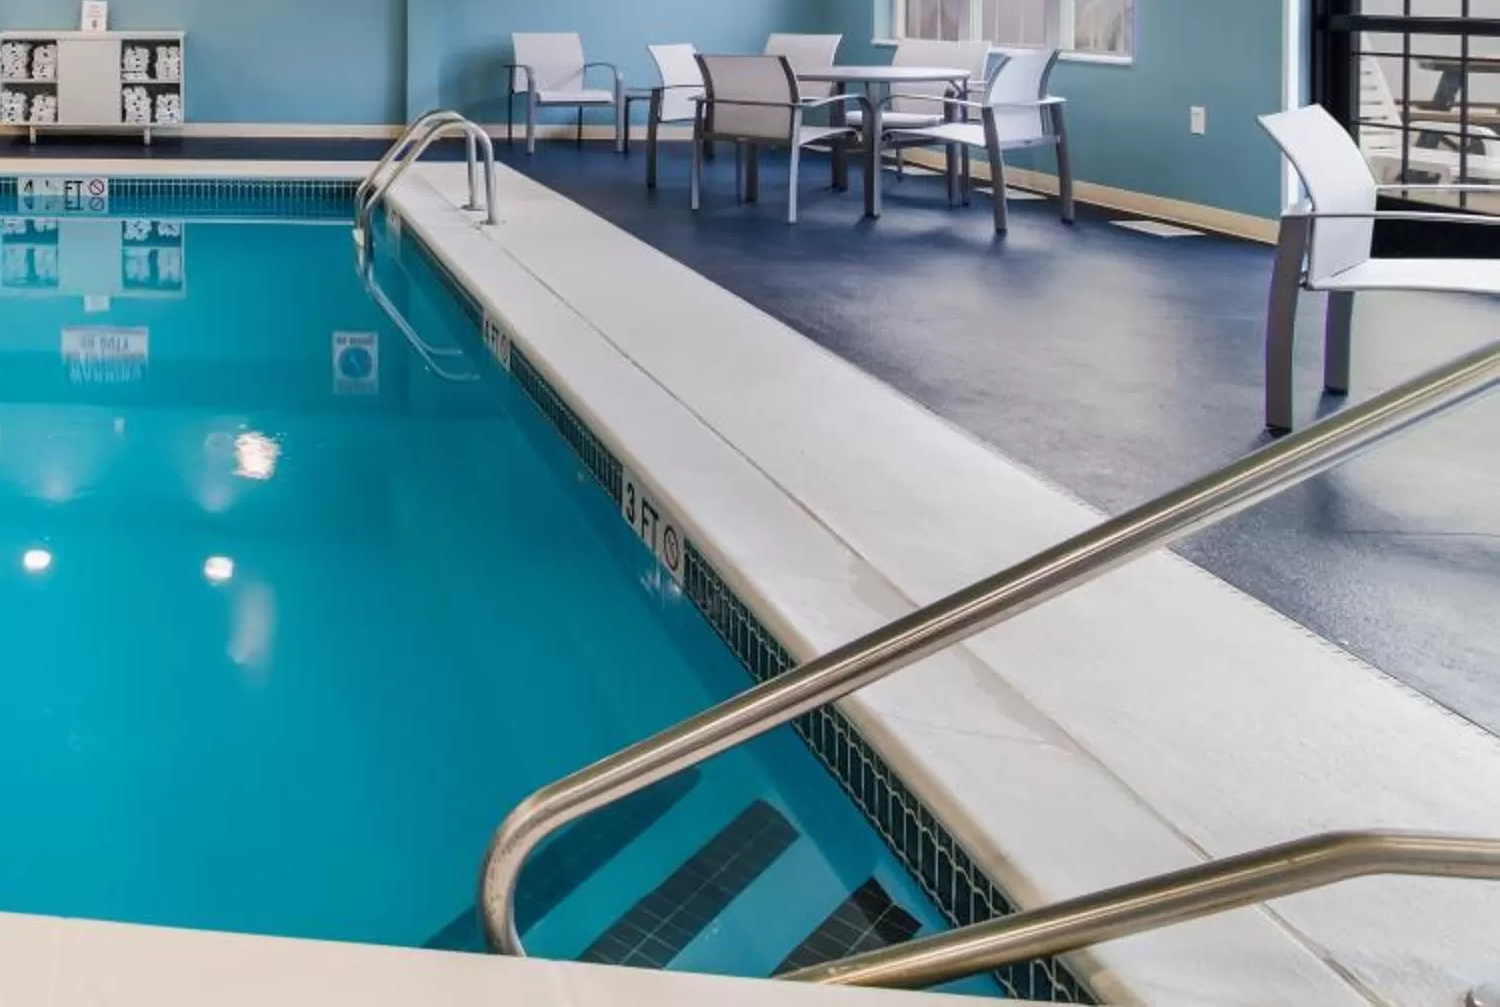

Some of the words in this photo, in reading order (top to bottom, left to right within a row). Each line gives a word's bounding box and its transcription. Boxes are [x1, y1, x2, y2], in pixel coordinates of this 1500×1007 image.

[64, 180, 84, 196] FT
[626, 482, 635, 525] 3
[641, 496, 660, 551] FT
